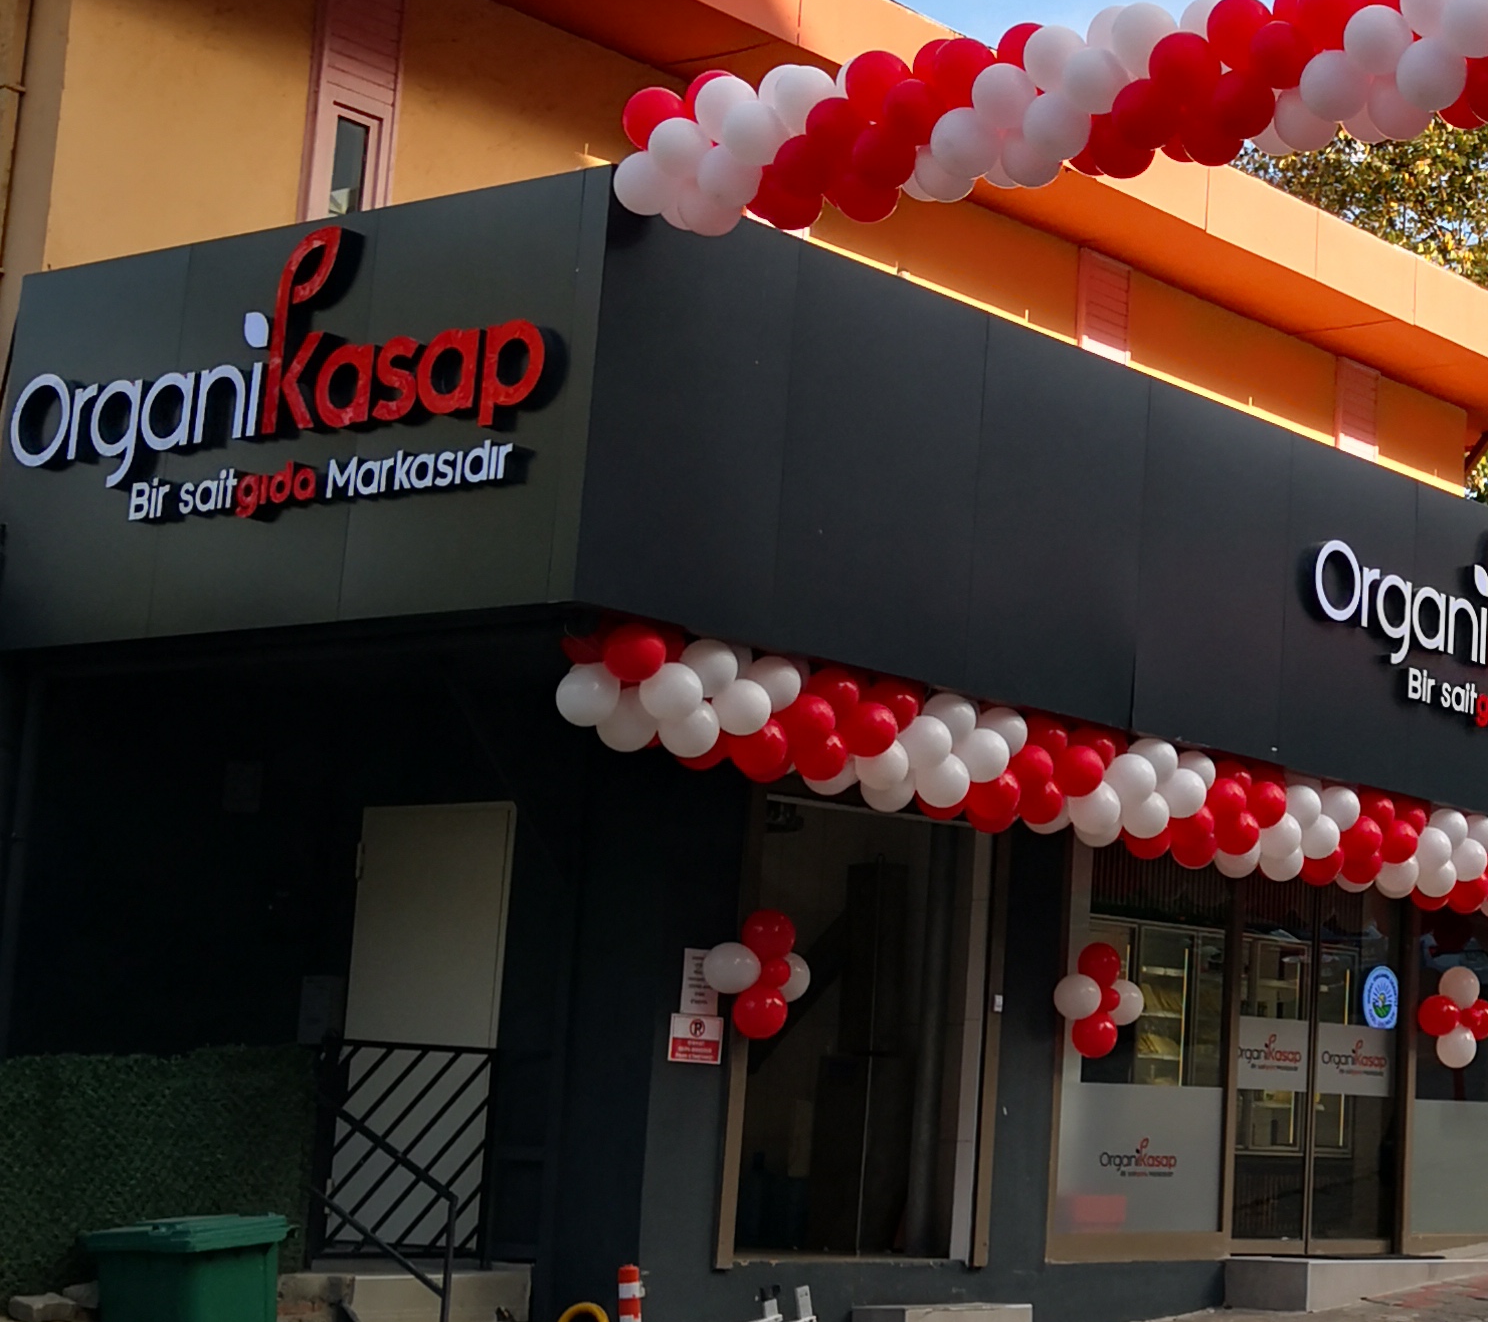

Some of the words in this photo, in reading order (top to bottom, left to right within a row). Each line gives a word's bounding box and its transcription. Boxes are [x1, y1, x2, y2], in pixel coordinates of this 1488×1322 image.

[128, 477, 169, 522] Bir
[325, 440, 513, 499] Markasıdır
[1407, 666, 1436, 704] Bir
